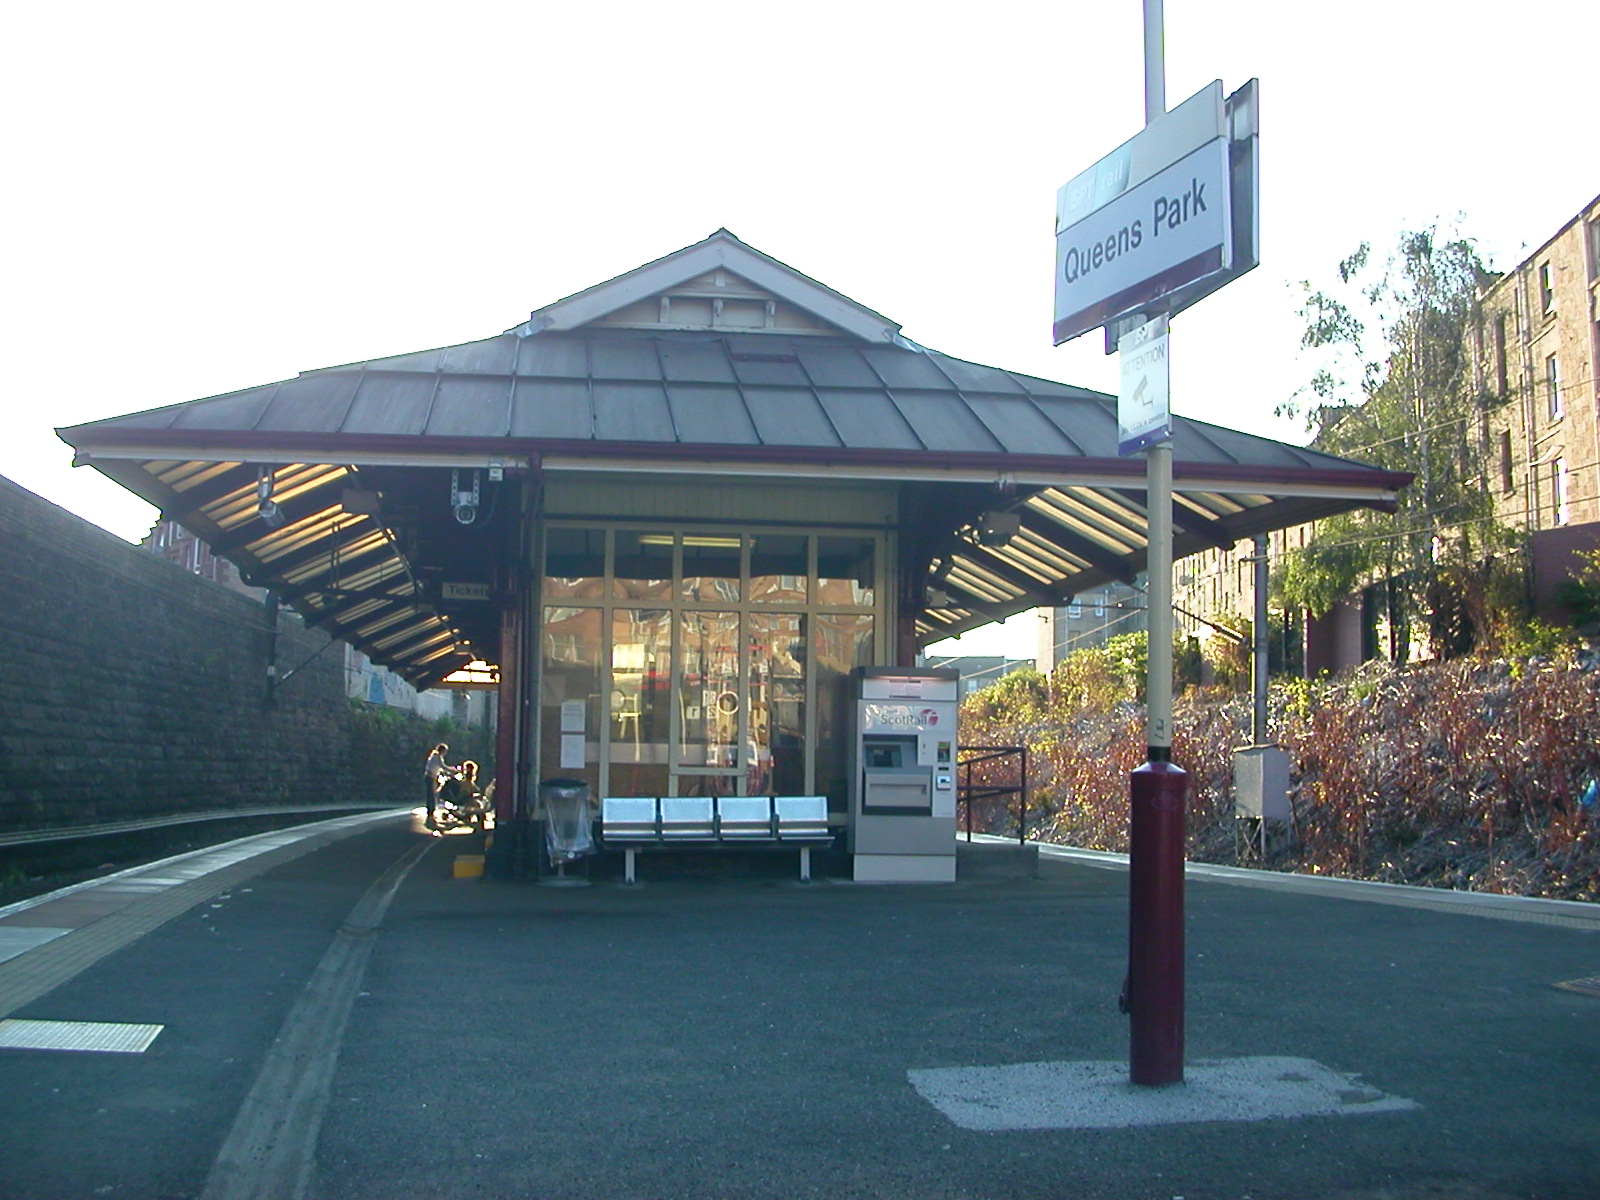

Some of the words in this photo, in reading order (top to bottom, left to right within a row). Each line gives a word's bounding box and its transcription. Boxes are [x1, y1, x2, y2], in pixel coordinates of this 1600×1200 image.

[1063, 219, 1142, 284] Queens
[1154, 177, 1207, 237] Park
[1123, 343, 1165, 376] ATTENTION
[880, 713, 927, 725] ScotRail
